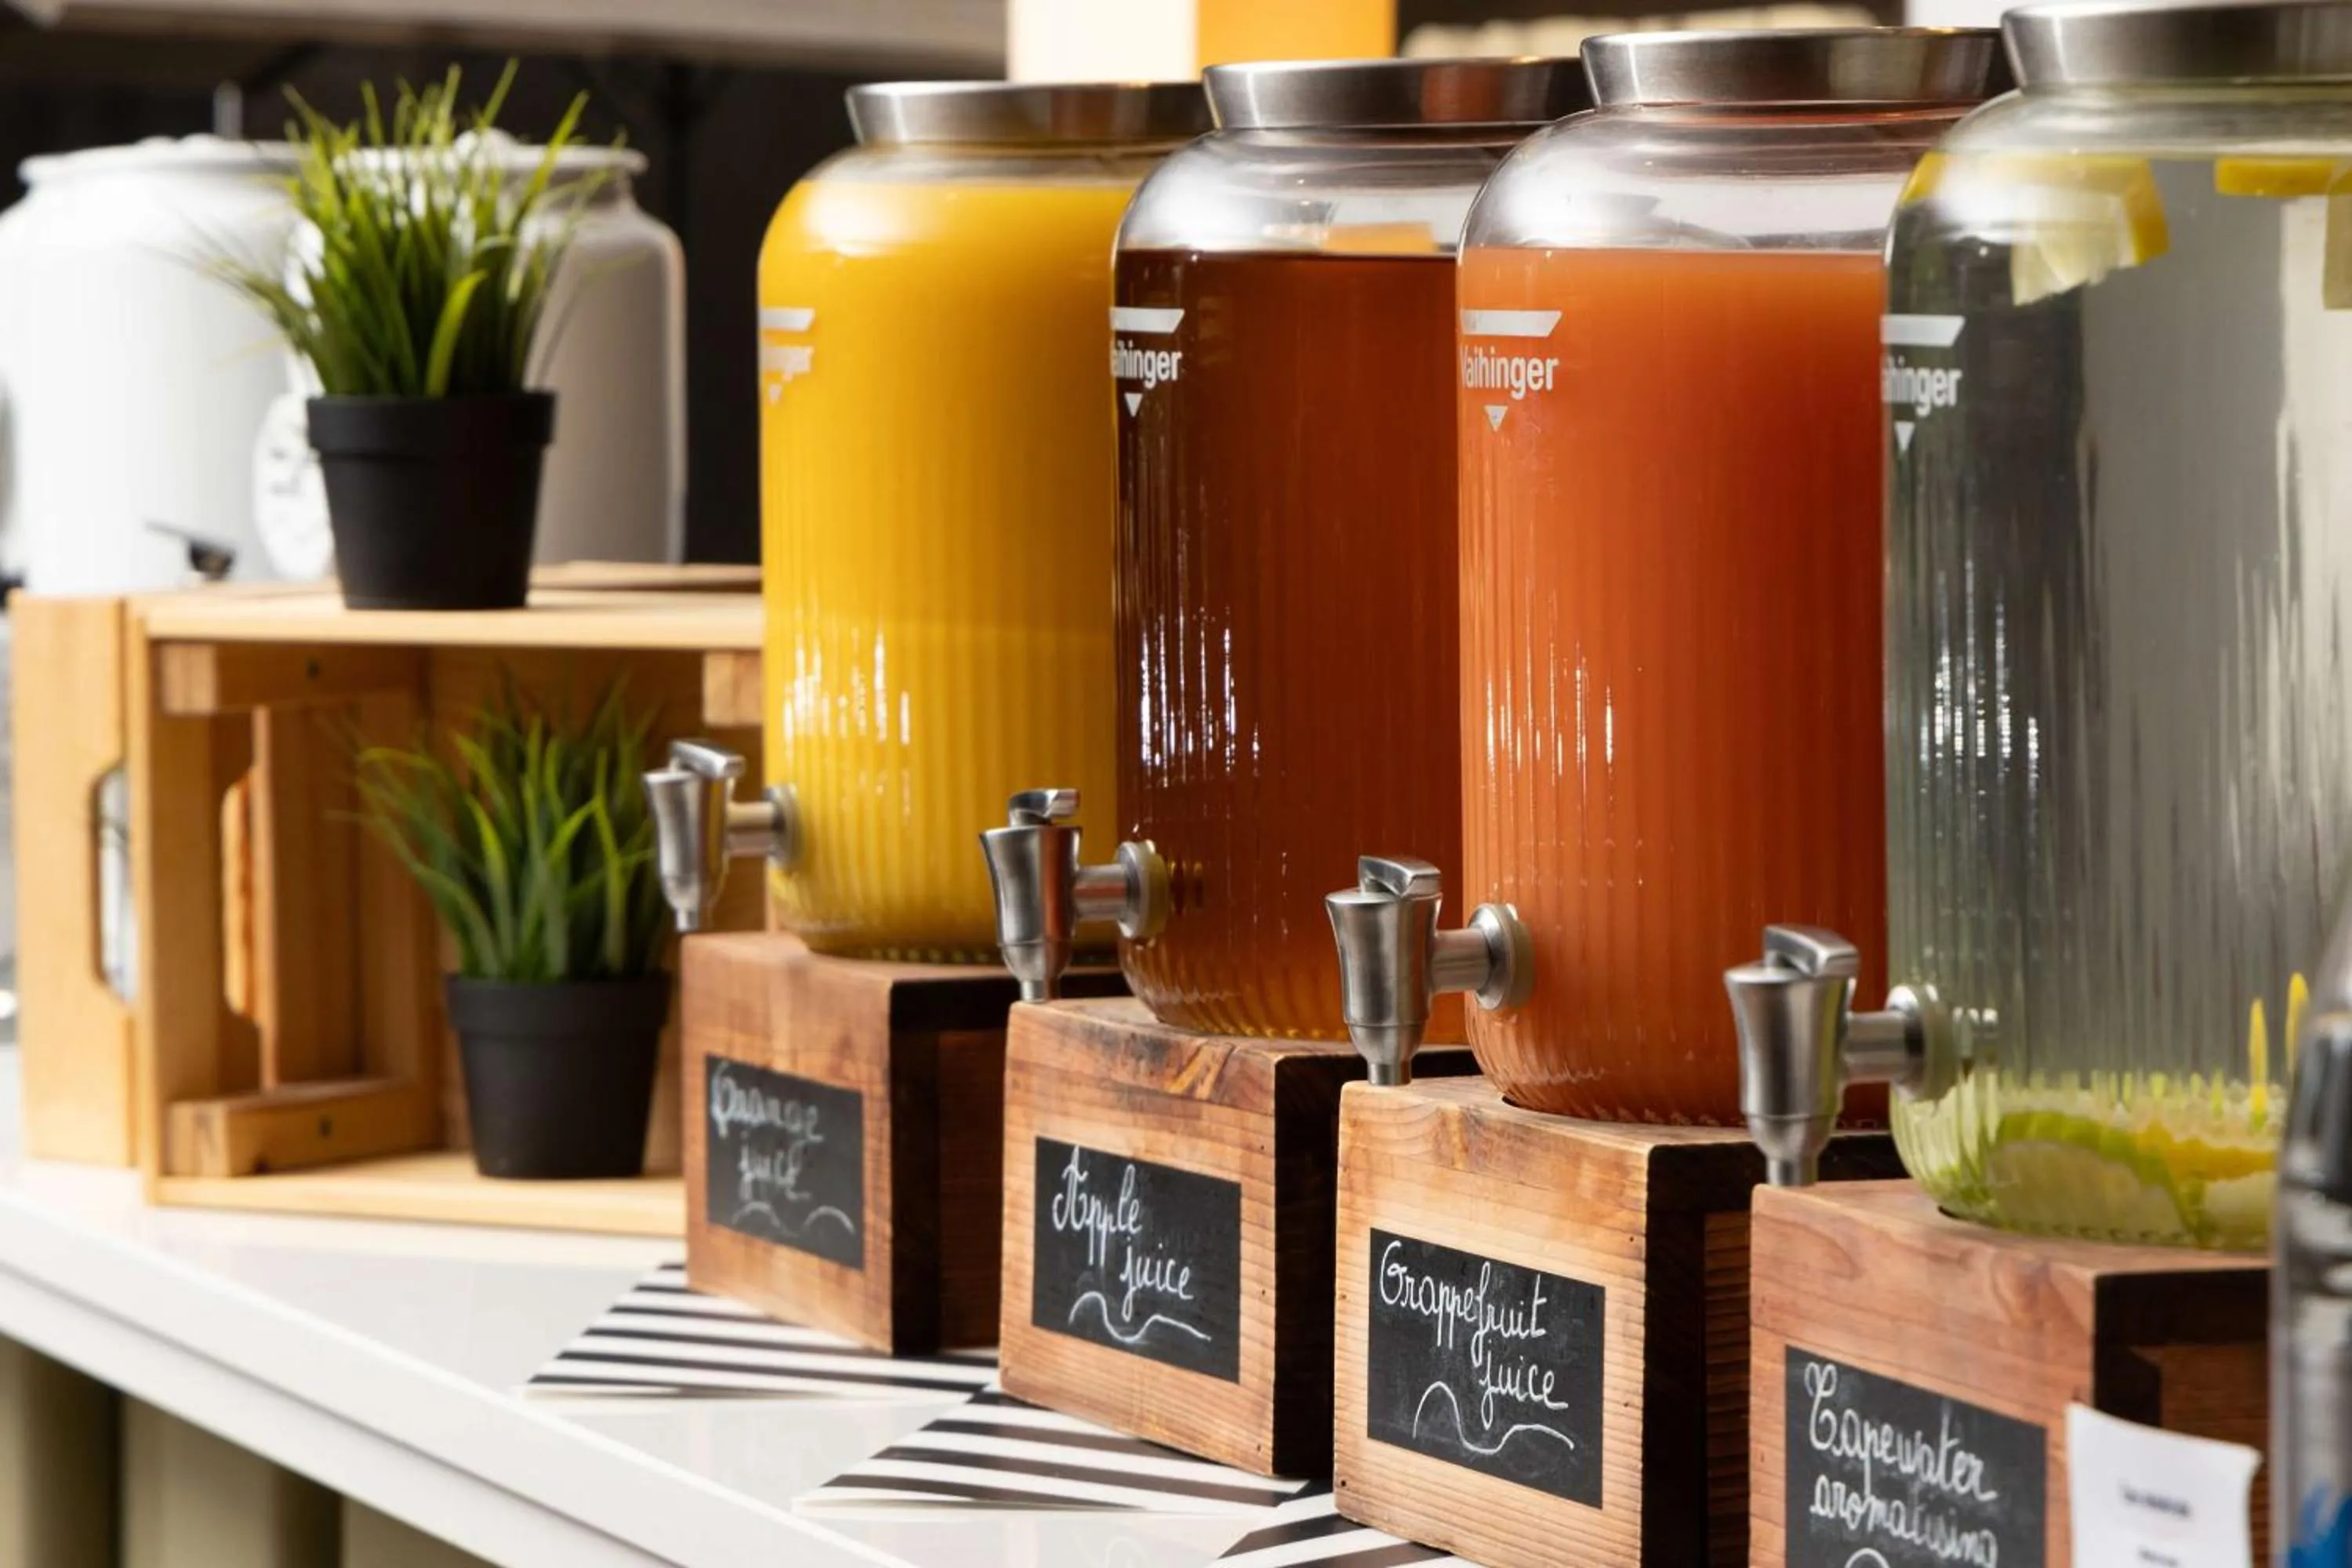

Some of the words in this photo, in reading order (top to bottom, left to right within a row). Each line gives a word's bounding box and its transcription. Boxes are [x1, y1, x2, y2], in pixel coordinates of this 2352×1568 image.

[1052, 1145, 1142, 1266] Apple
[1120, 1236, 1194, 1323] juice
[1380, 1240, 1547, 1367] Grappefruit
[1479, 1340, 1569, 1430] juice
